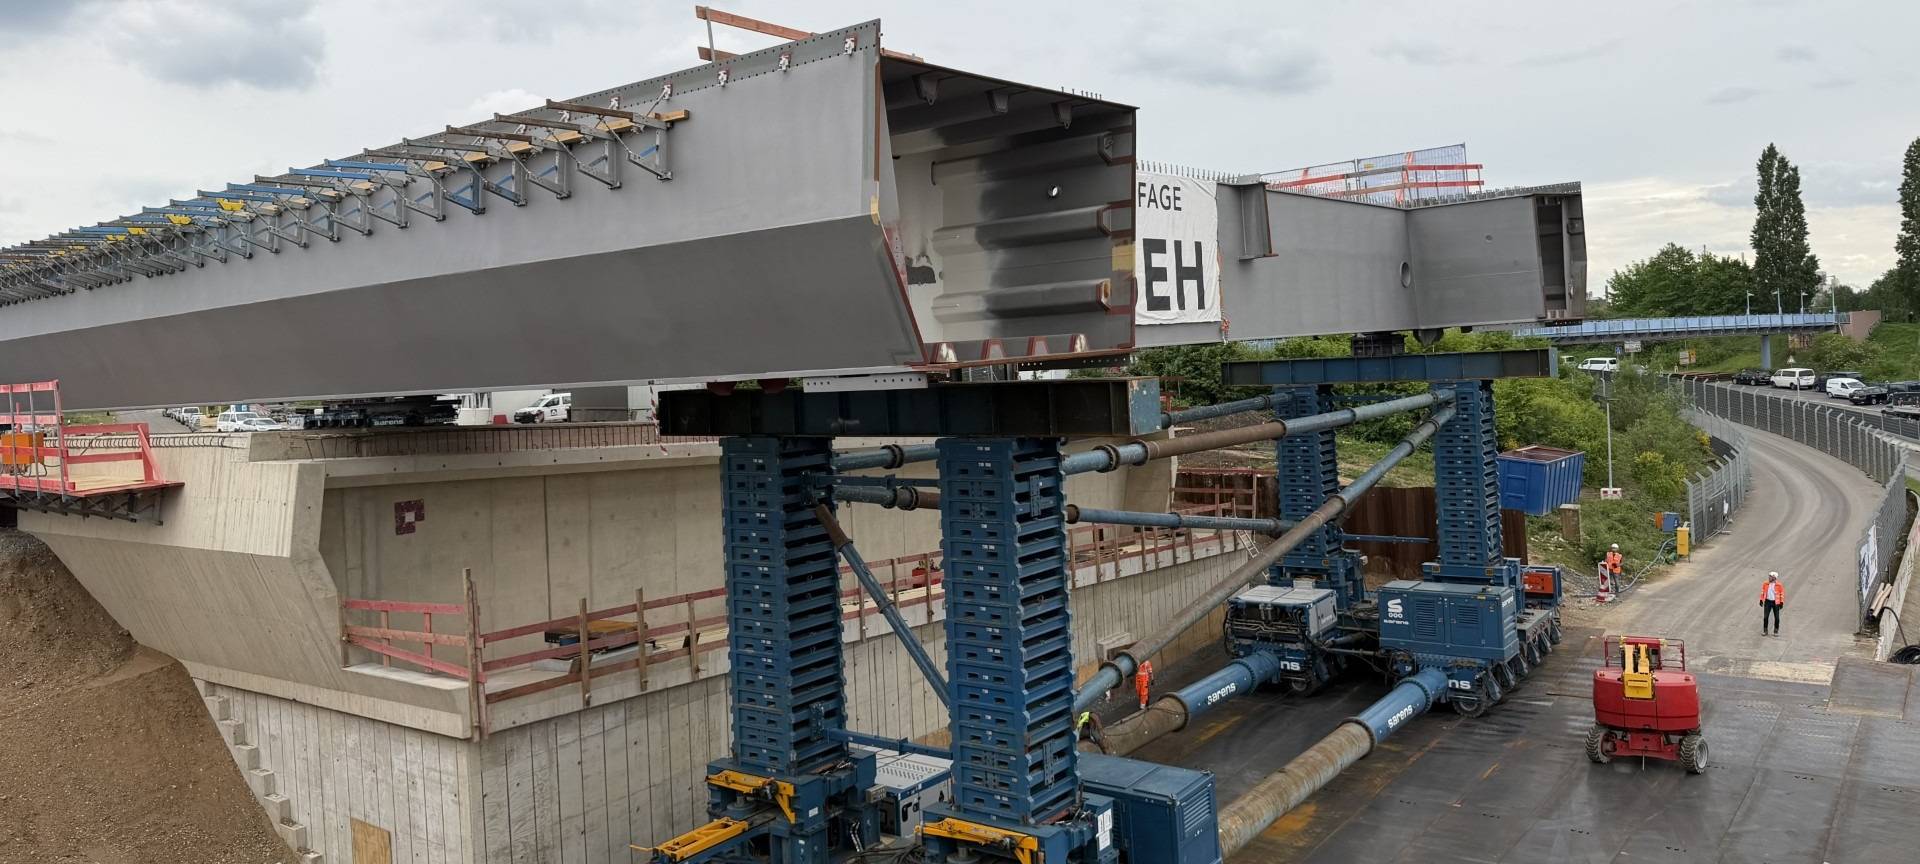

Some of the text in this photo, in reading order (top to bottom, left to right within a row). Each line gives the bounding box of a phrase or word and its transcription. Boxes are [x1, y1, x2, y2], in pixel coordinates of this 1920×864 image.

[1135, 238, 1206, 311] EH
[1207, 682, 1237, 706] sarens
[1387, 704, 1414, 729] sarens
